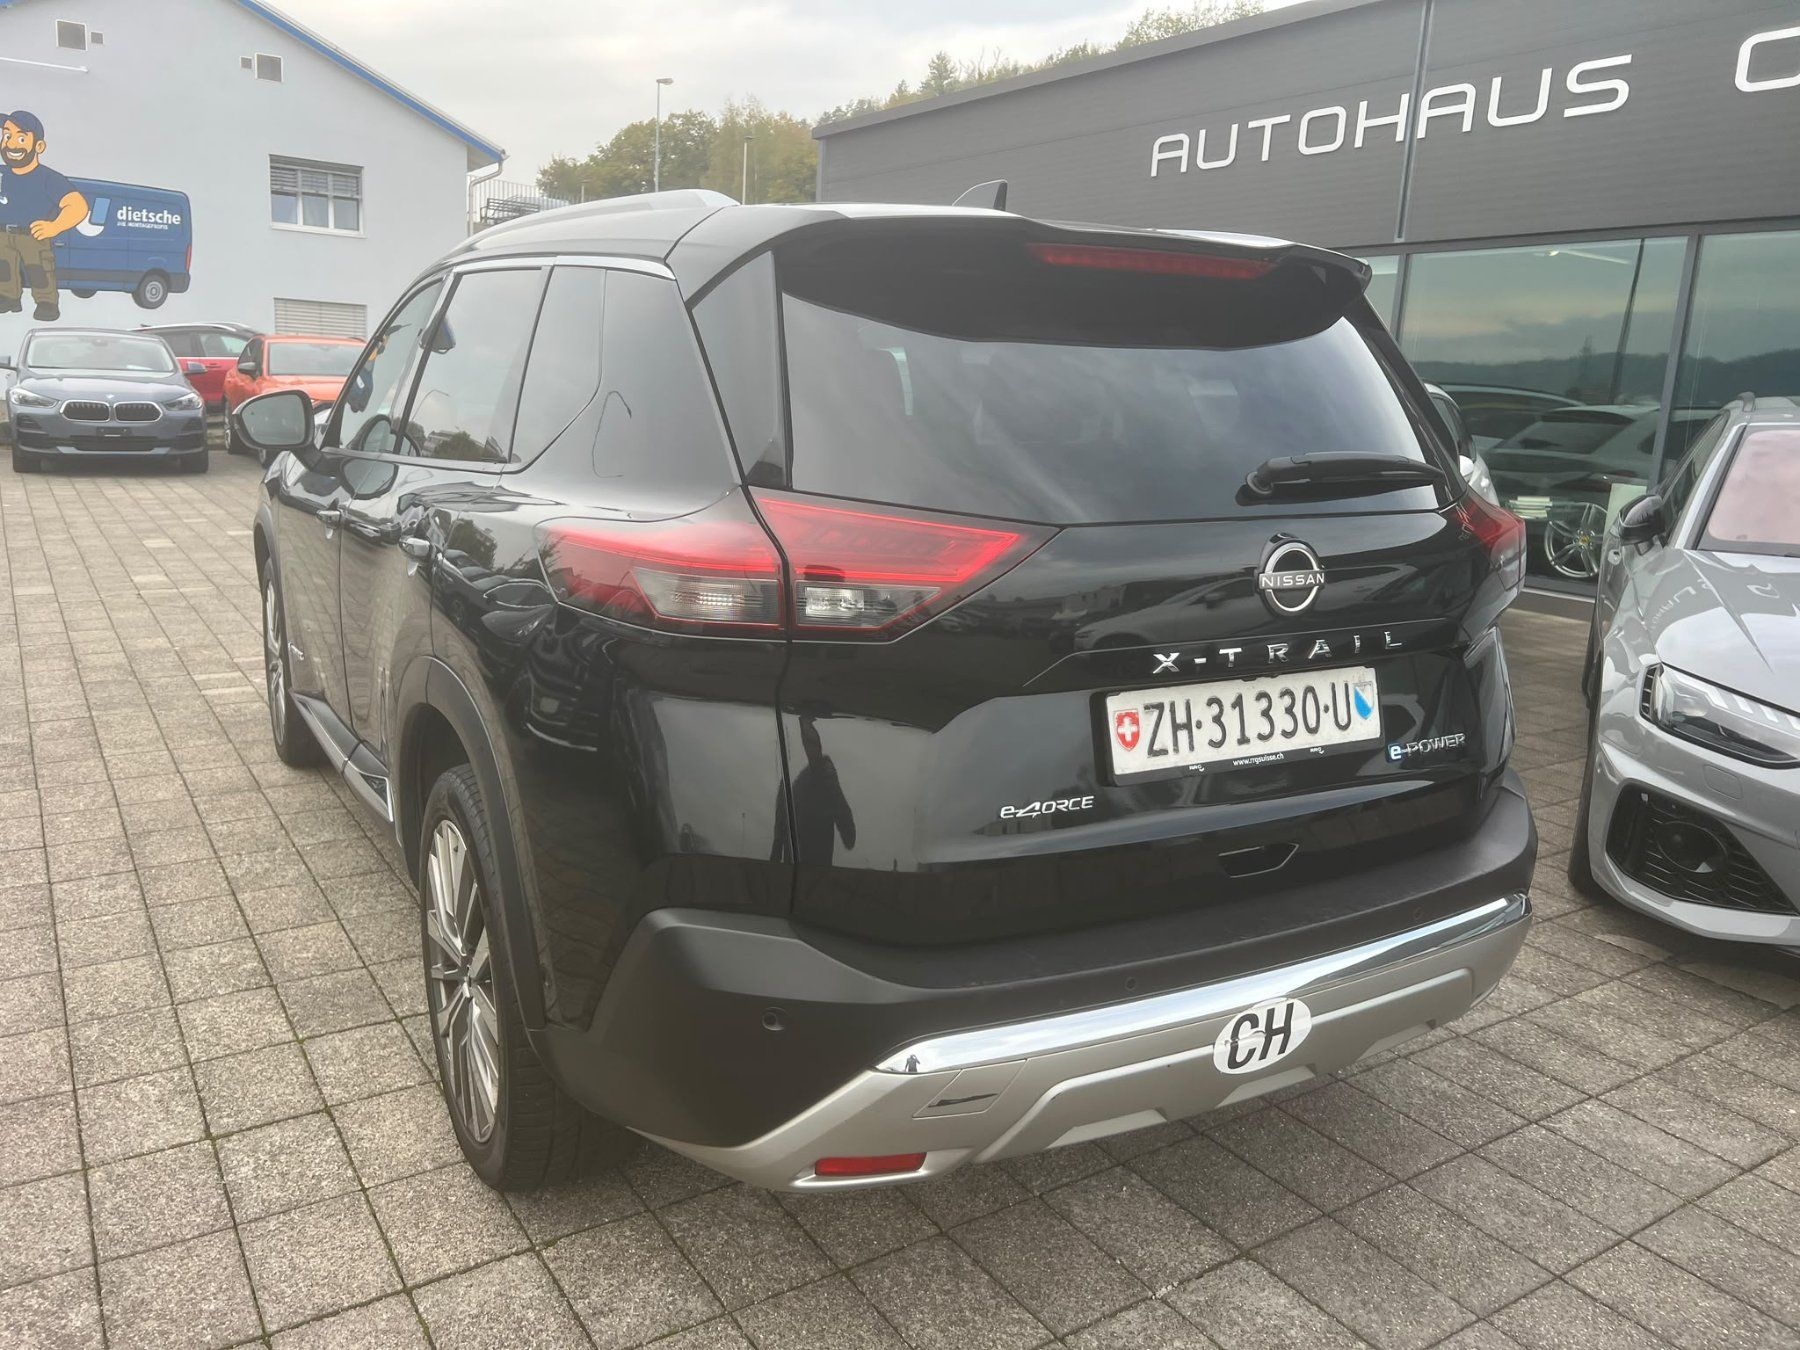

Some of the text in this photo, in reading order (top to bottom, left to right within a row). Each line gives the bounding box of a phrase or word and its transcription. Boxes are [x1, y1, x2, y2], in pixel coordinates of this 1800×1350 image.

[1150, 54, 1632, 178] AUTOHAUS
[116, 205, 181, 225] dietsche
[1261, 572, 1325, 588] NISSAN
[1153, 631, 1402, 674] X-TRAIL
[1227, 1001, 1295, 1070] CH
